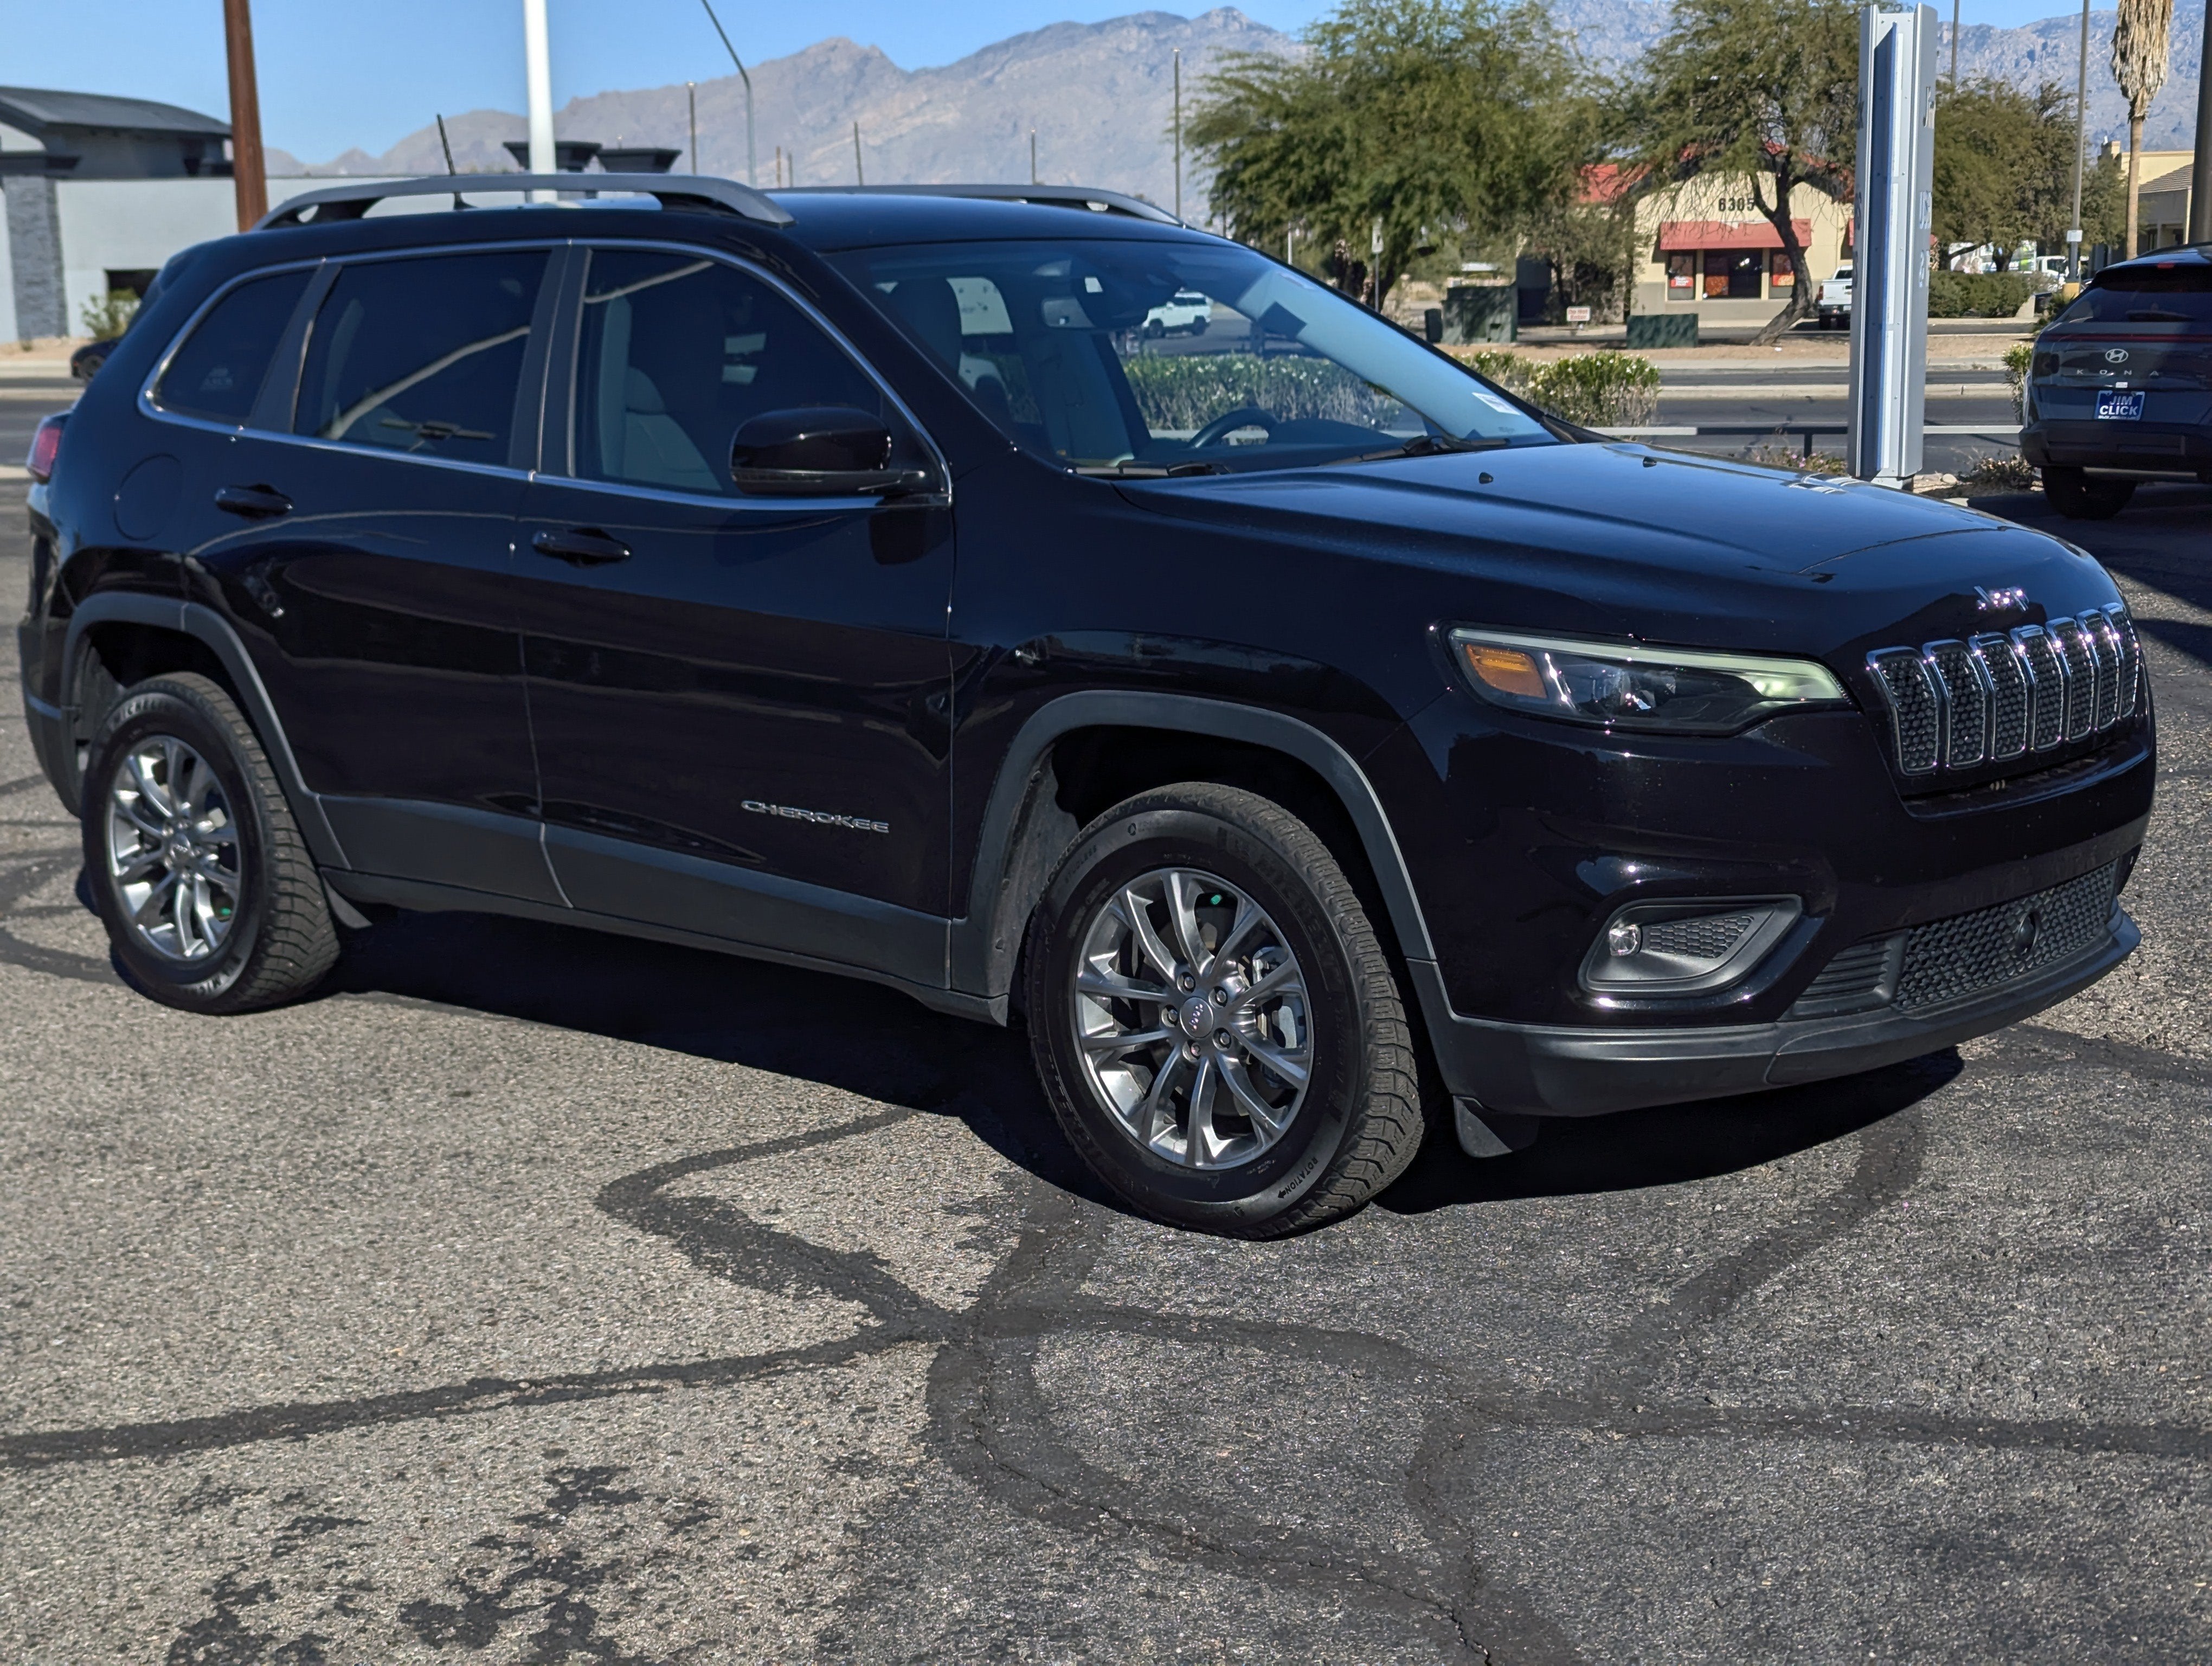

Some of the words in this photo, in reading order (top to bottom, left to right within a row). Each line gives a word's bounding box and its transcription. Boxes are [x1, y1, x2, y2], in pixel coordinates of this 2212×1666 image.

[1719, 197, 1755, 212] 6305
[2109, 395, 2133, 405] JIM
[2099, 405, 2138, 415] CLICK
[741, 800, 889, 834] CHEROKEE
[1285, 1157, 1318, 1195] ROTATION
